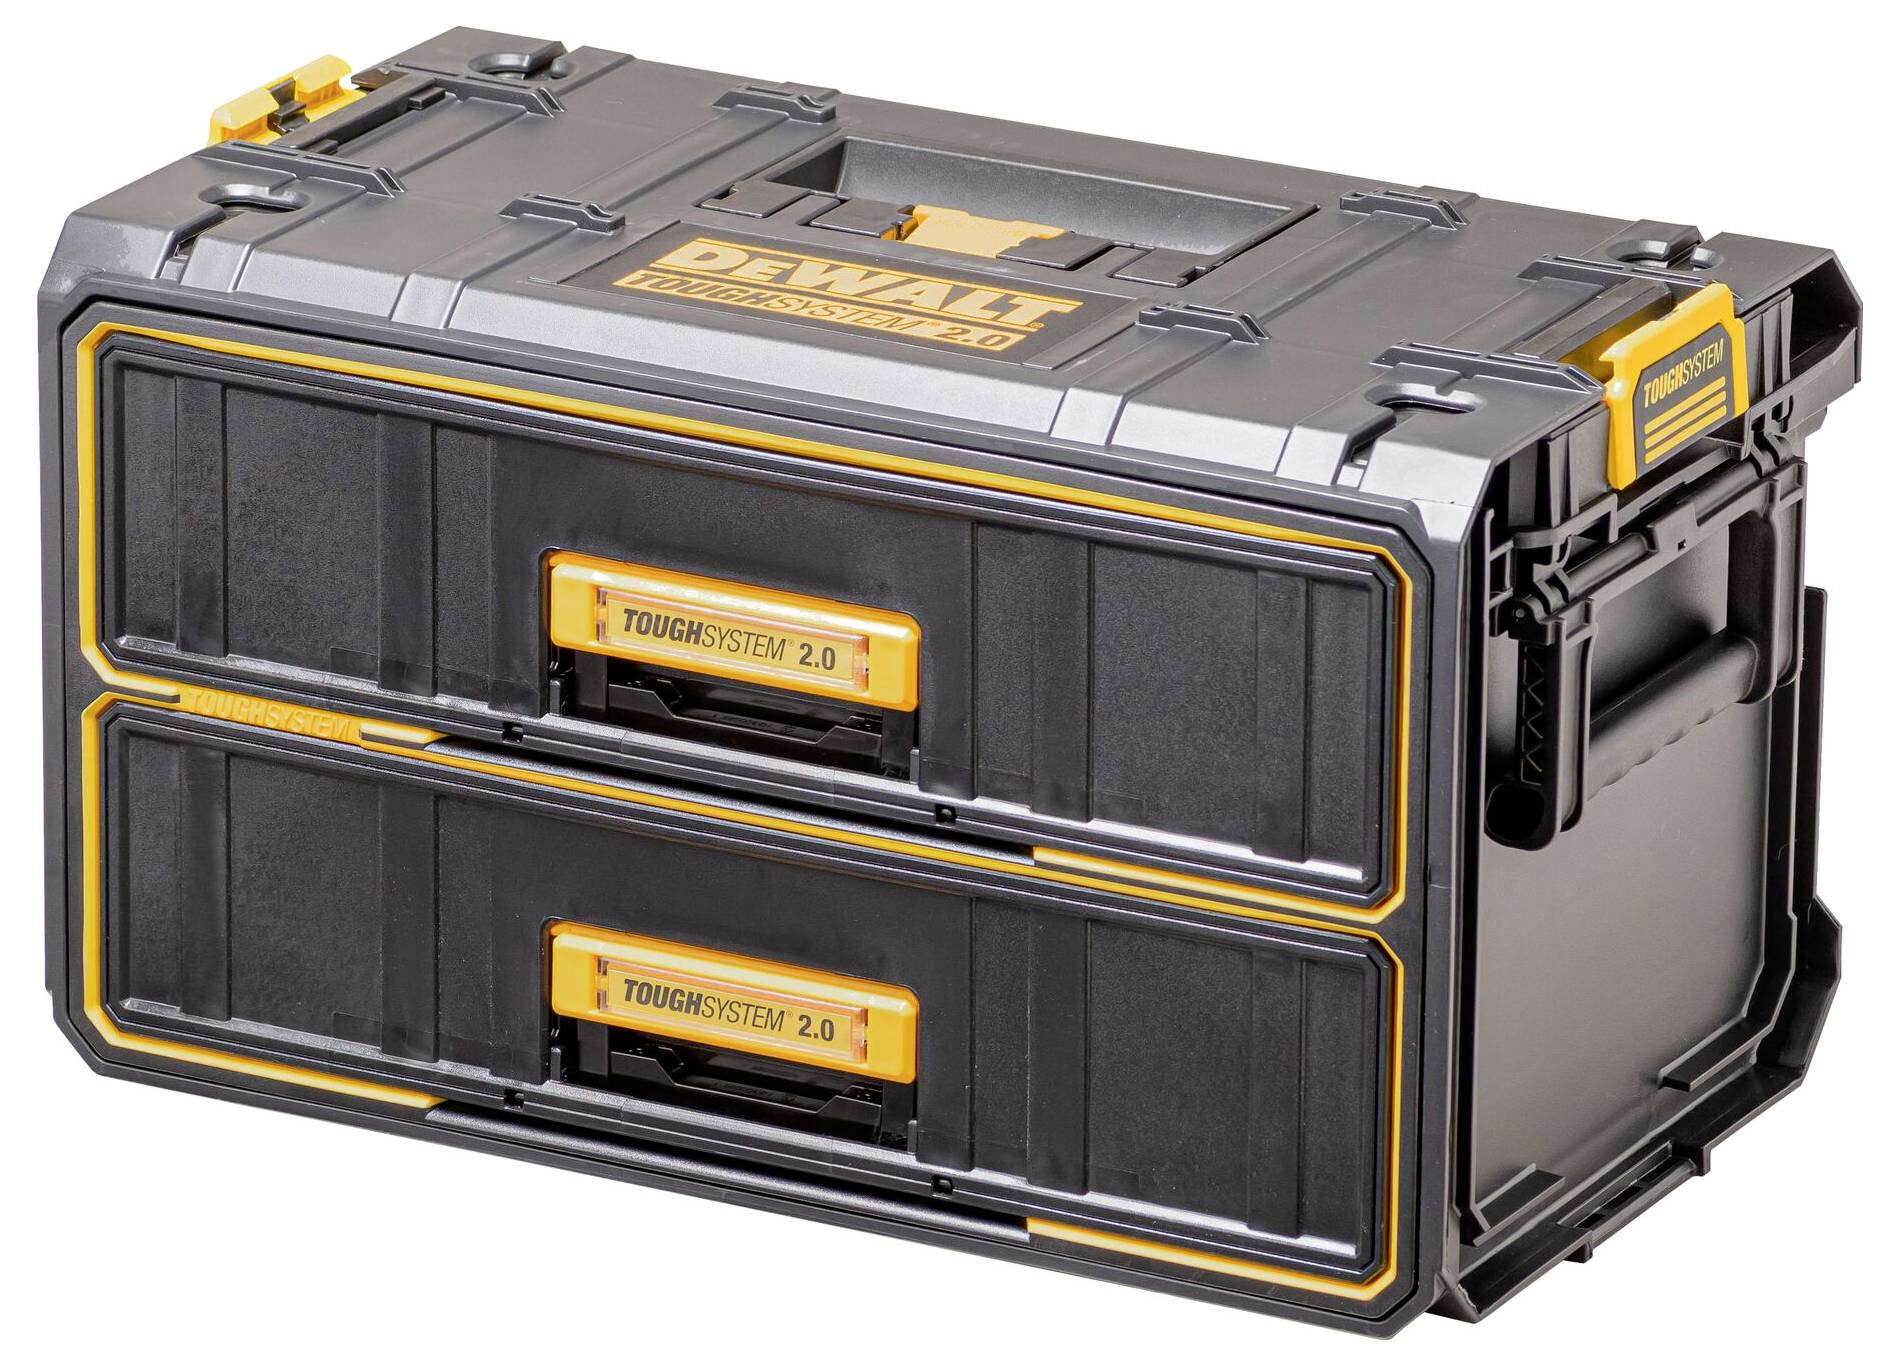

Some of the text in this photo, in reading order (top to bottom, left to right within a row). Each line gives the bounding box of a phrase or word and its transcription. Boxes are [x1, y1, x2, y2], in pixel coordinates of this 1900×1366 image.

[935, 326, 1012, 347] 2.0
[1644, 338, 1724, 408] TOUGHSYSTEM
[798, 642, 836, 671] 2.0
[188, 689, 350, 741] TOUGHSYSTEM
[798, 1014, 835, 1042] 2.0
